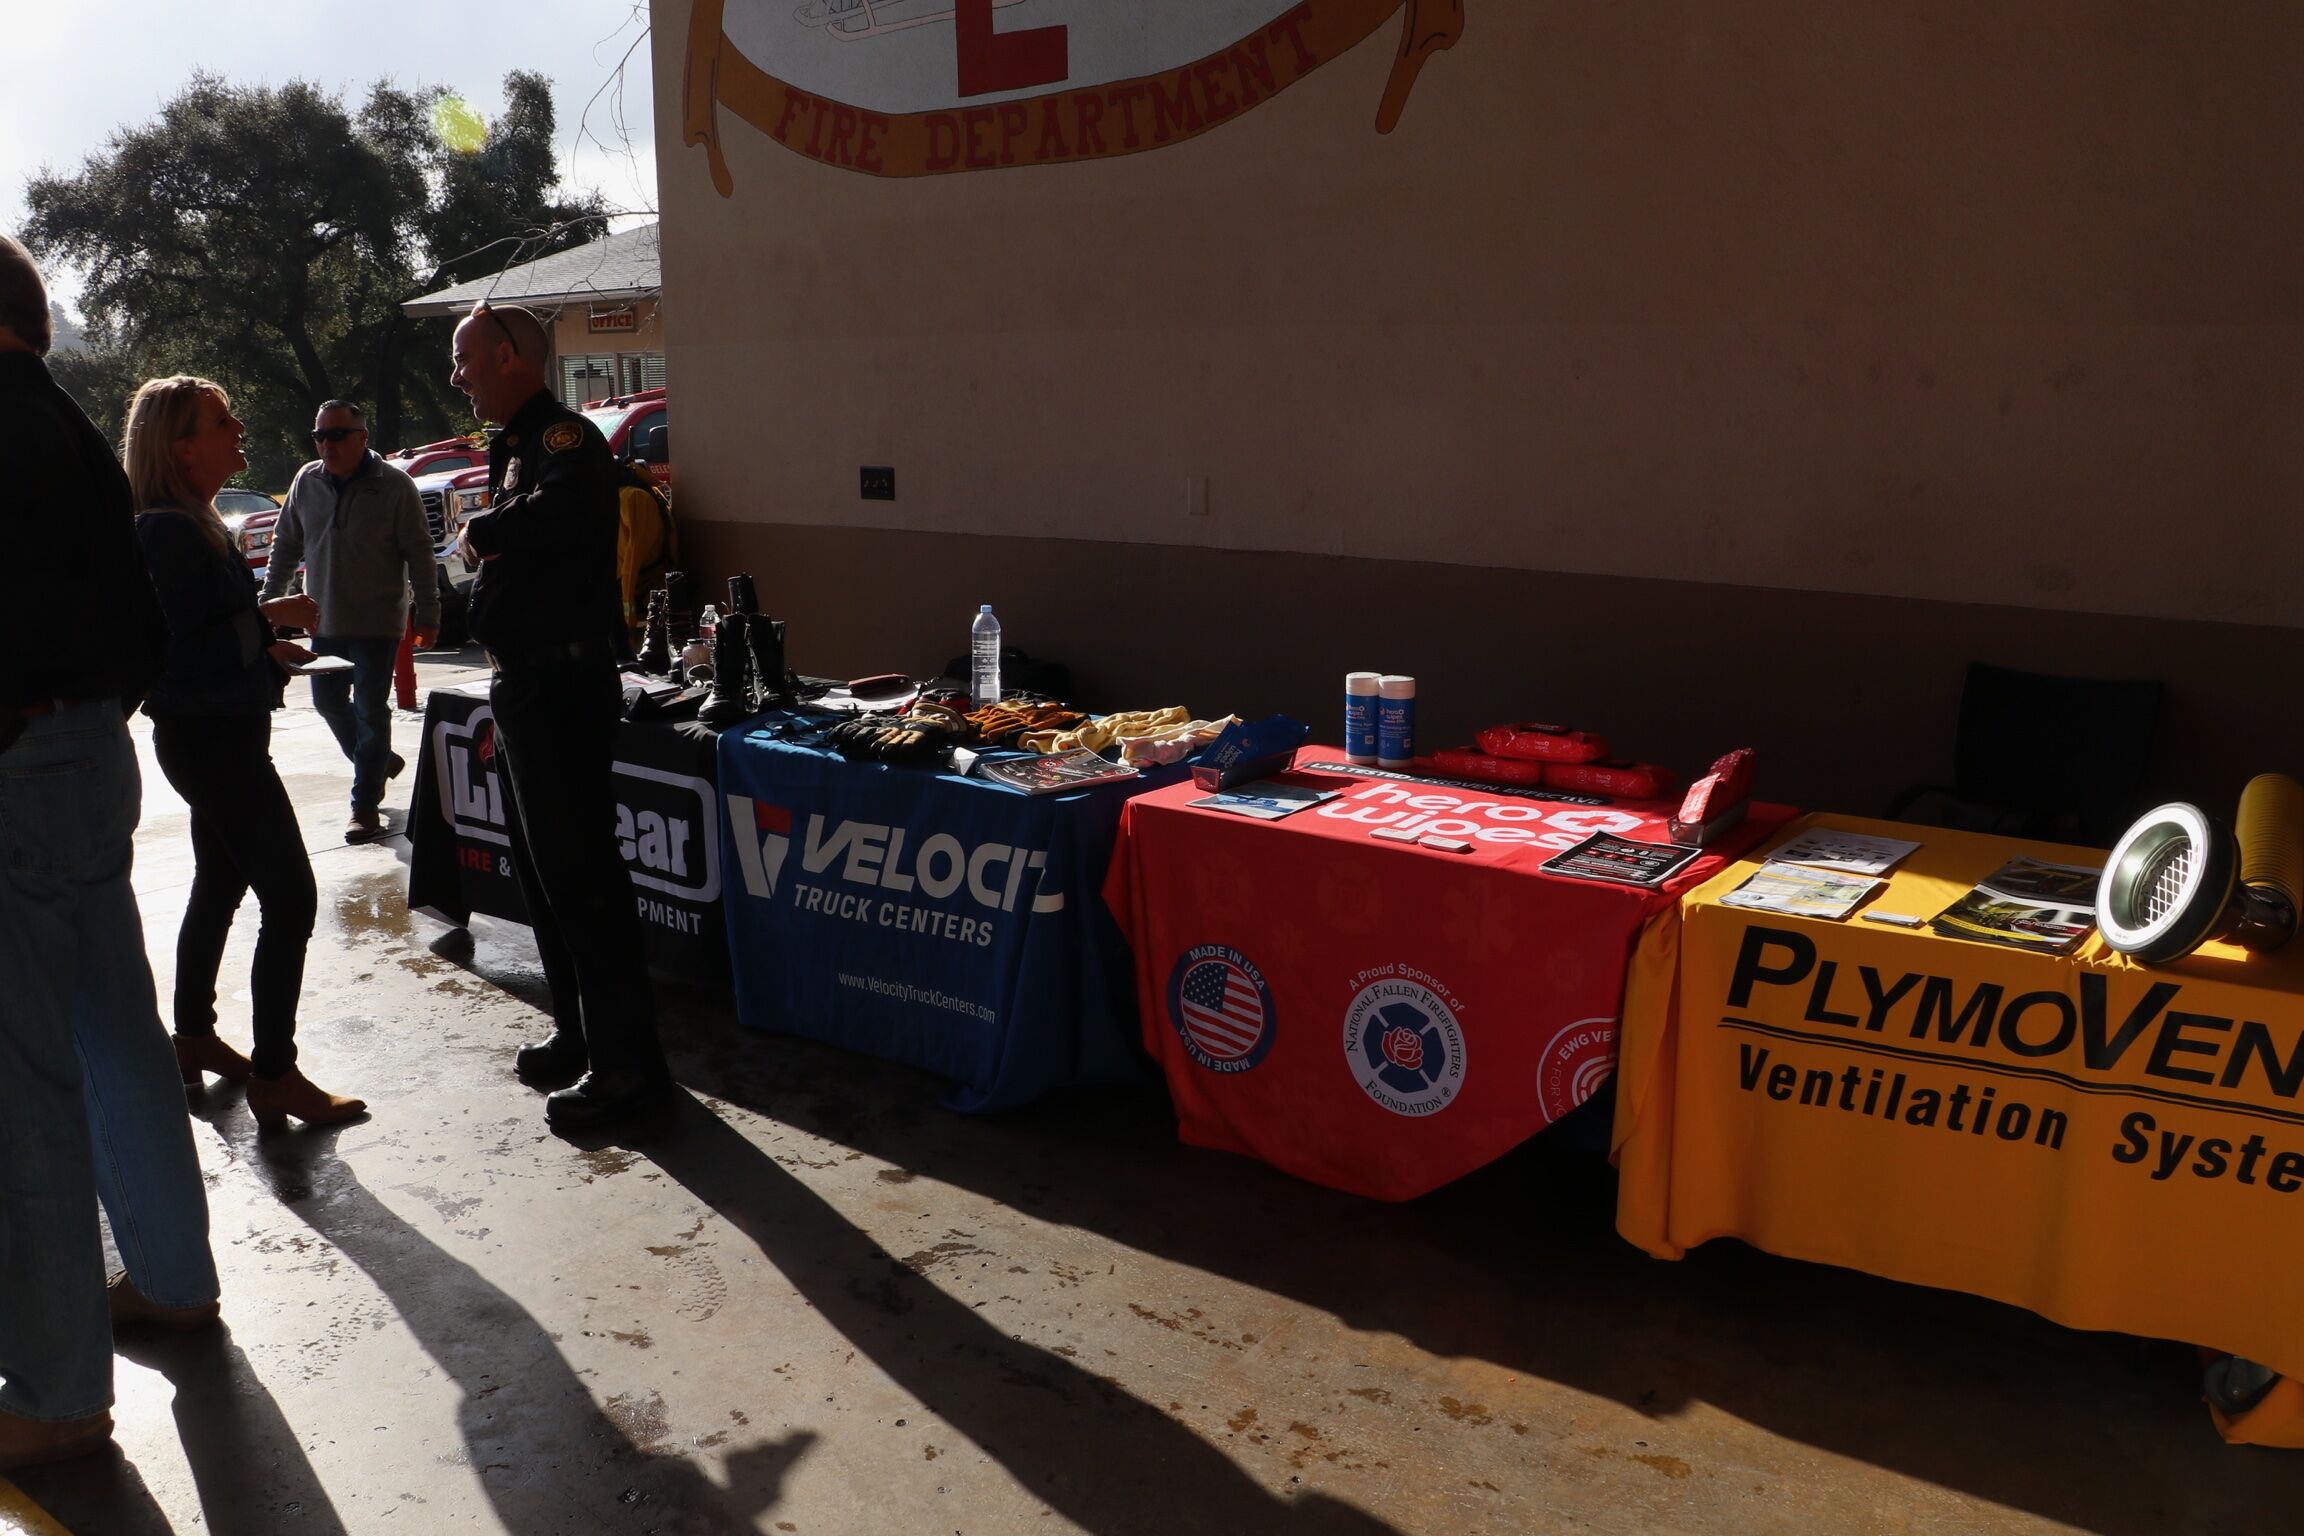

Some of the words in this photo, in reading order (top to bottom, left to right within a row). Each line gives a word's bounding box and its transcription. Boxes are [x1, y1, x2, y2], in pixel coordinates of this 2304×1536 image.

[773, 87, 890, 172] FIRE
[925, 4, 1318, 171] DEPARTMENT
[592, 313, 632, 328] OFFICE
[1310, 762, 1346, 771] LAB
[1503, 787, 1602, 806] EFFECTIVE
[1351, 783, 1543, 821] hero
[1316, 802, 1586, 850] wipes
[456, 846, 493, 873] IRE
[637, 896, 702, 935] PMENT
[794, 883, 872, 923] TRUCK
[878, 902, 993, 948] CENTERS
[1188, 945, 1226, 961] MADE
[1228, 949, 1243, 966] IN
[1243, 960, 1265, 990] USA
[1349, 978, 1360, 992] A
[1357, 962, 1395, 983] Proud
[1398, 962, 1452, 998] Sponsor
[1449, 997, 1466, 1013] of
[838, 971, 996, 1025] www.VelocityTruckCenters.com
[1179, 1026, 1197, 1056] USA
[1345, 994, 1375, 1053] NATIONAL
[1371, 984, 1419, 1000] FALLEN
[1419, 990, 1461, 1079] FIREFIGHTERS
[1557, 1033, 1590, 1061] EWG
[1197, 1052, 1211, 1068] IN
[1214, 1057, 1251, 1072] MADE
[1550, 1067, 1562, 1097] FOR
[1364, 1079, 1443, 1115] FOUNDATION
[1738, 1043, 2069, 1151] Ventilation
[2111, 1111, 2304, 1194] Syste
